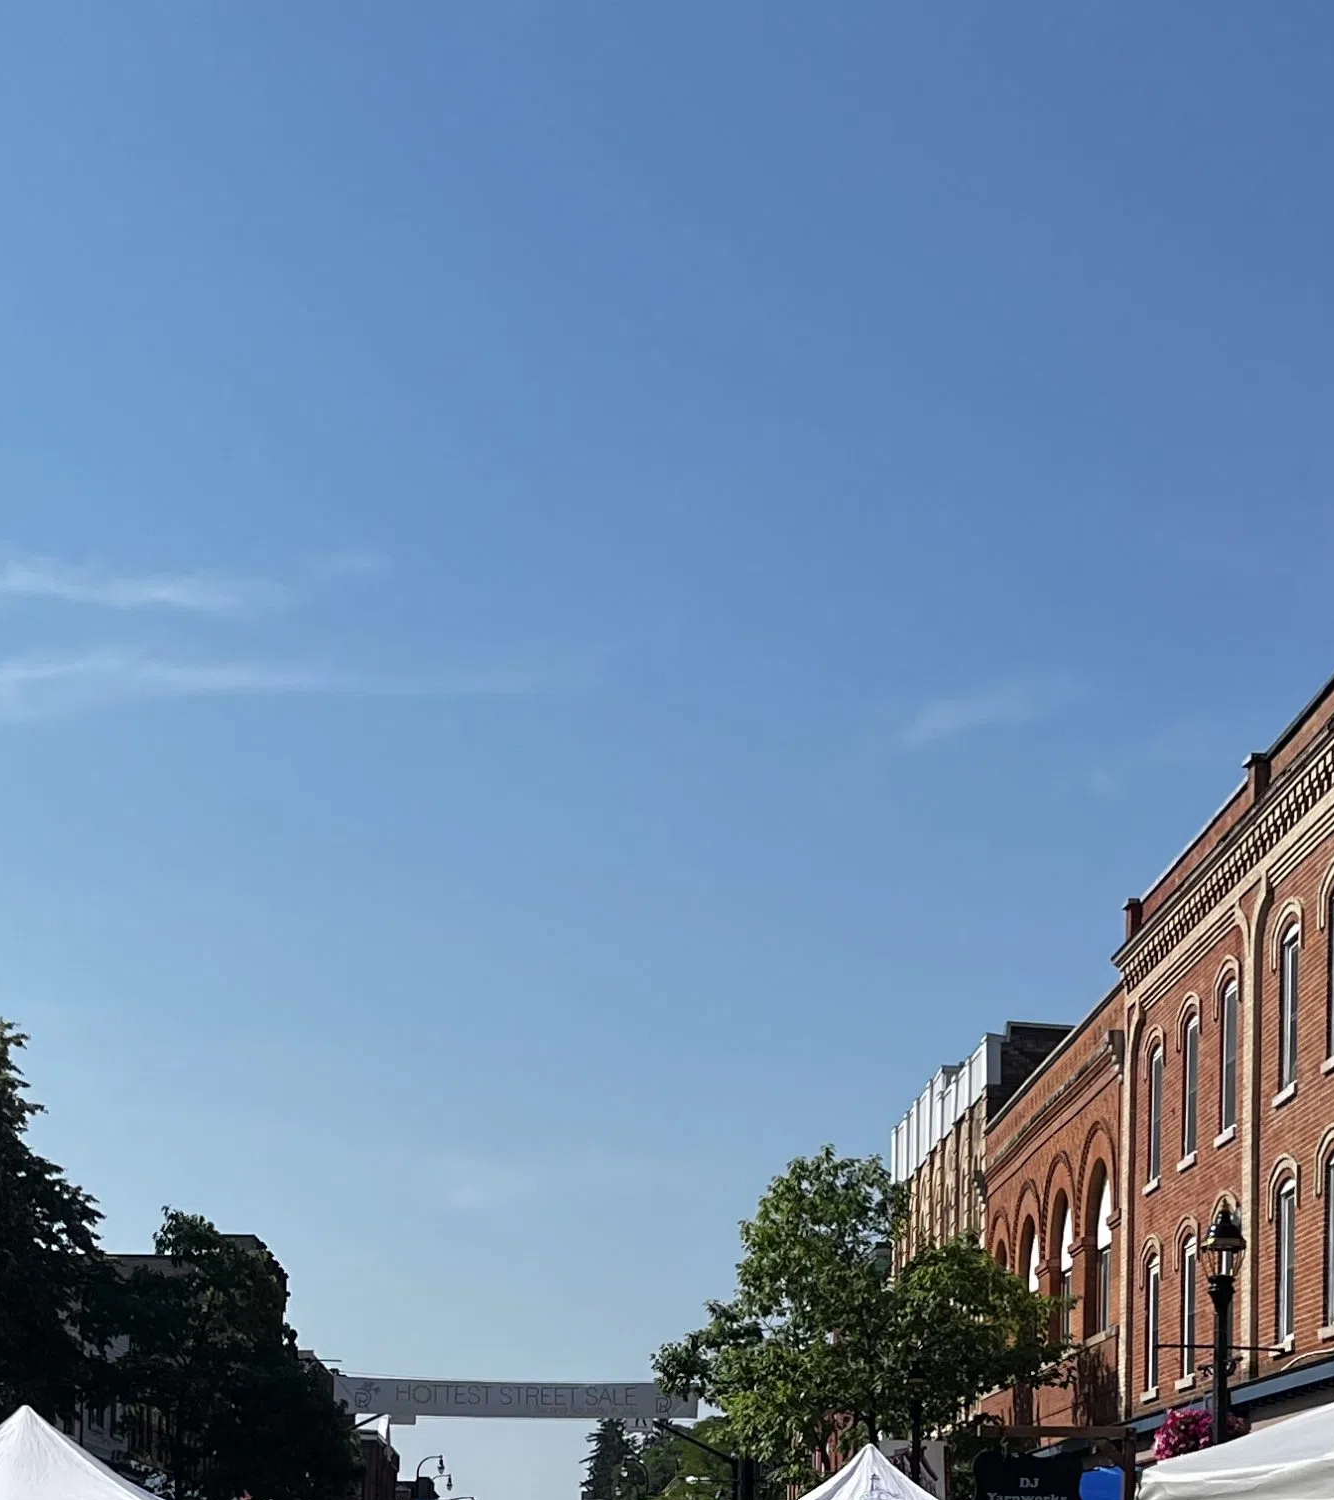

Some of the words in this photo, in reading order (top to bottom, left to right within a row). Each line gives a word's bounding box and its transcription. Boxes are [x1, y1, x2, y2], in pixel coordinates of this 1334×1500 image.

[395, 1385, 492, 1405] HOTTEST
[500, 1386, 581, 1406] STREET
[585, 1387, 638, 1407] SALE
[1018, 1477, 1040, 1488] DJ
